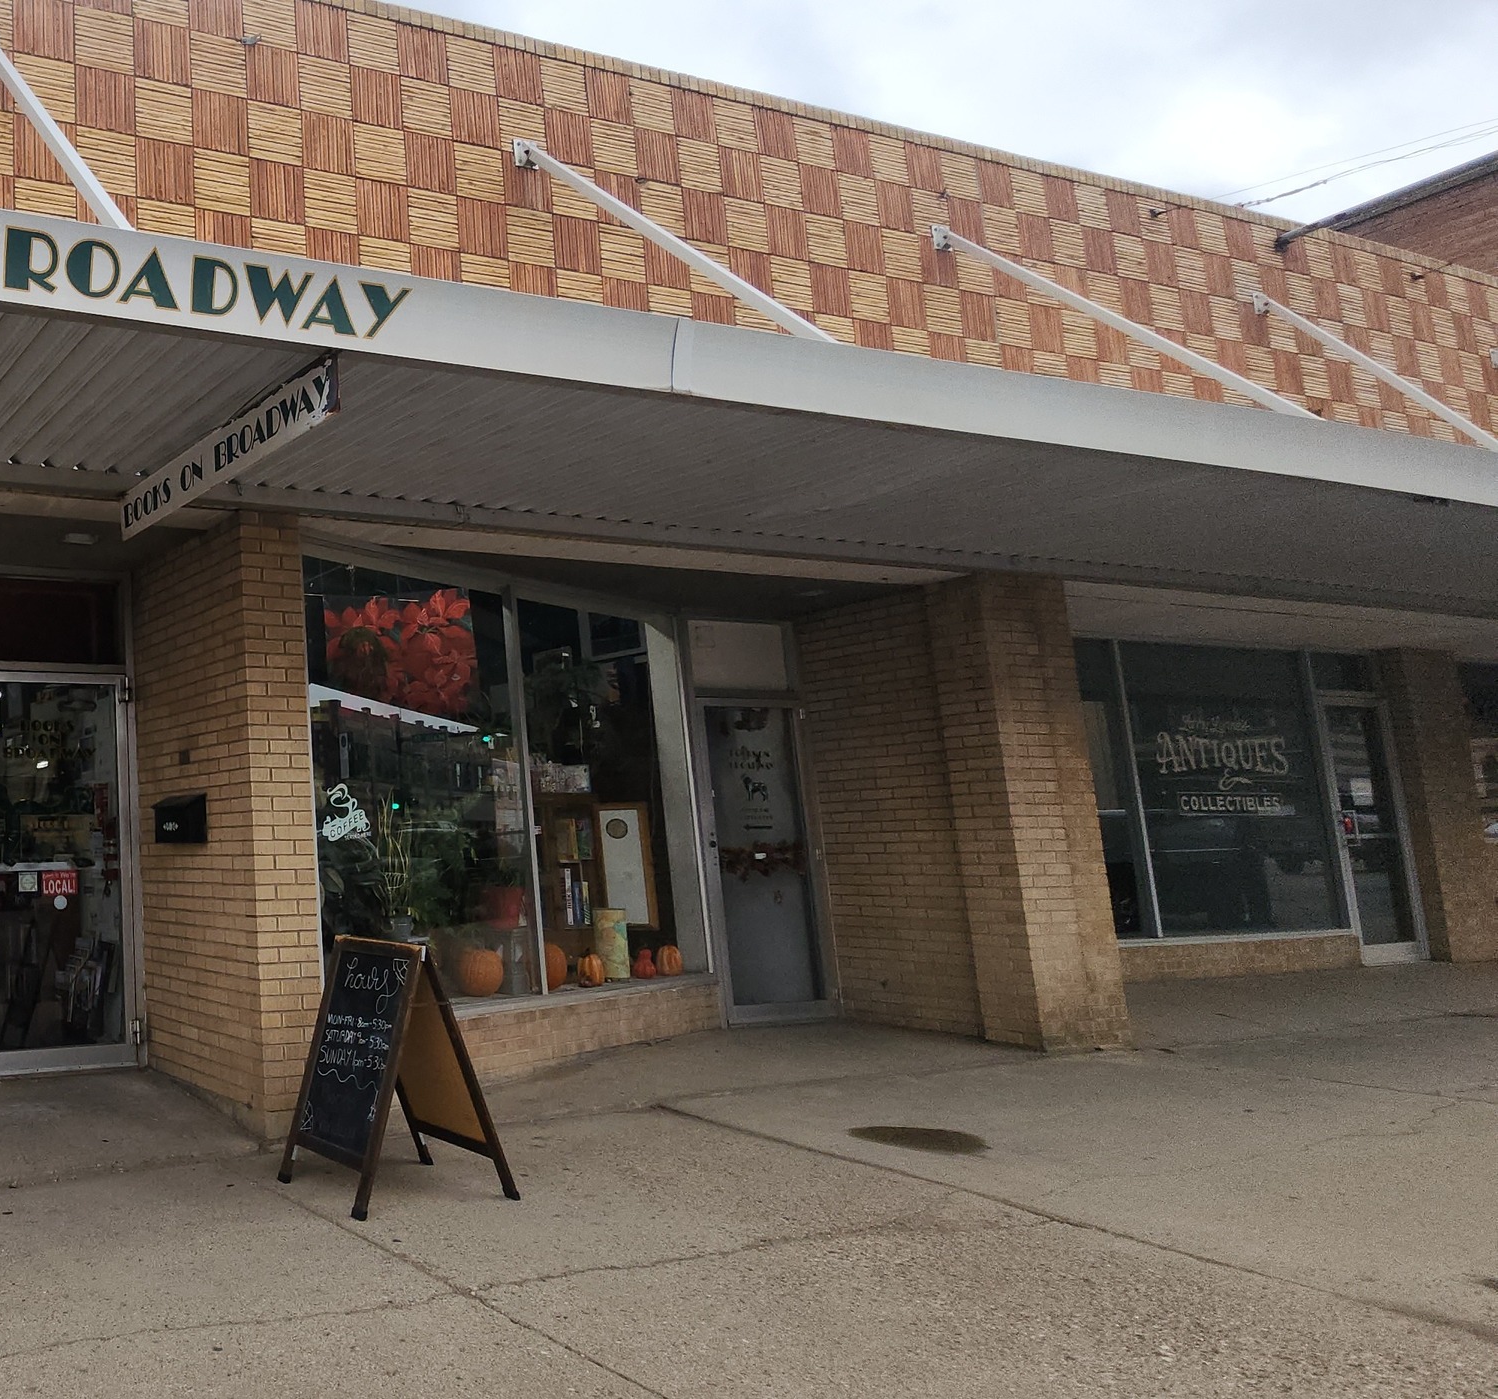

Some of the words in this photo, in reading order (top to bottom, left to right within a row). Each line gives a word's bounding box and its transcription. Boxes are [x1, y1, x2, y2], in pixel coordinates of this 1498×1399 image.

[123, 478, 171, 529] BOOKS
[180, 456, 203, 492] ON
[214, 375, 330, 473] BROADWAY
[1156, 731, 1290, 776] ANTIQUES
[1219, 768, 1253, 791] &
[1180, 795, 1282, 811] COLLECTIBLES
[329, 810, 365, 838] COFFEE
[43, 879, 76, 894] LOCAL!
[344, 957, 391, 997] hours
